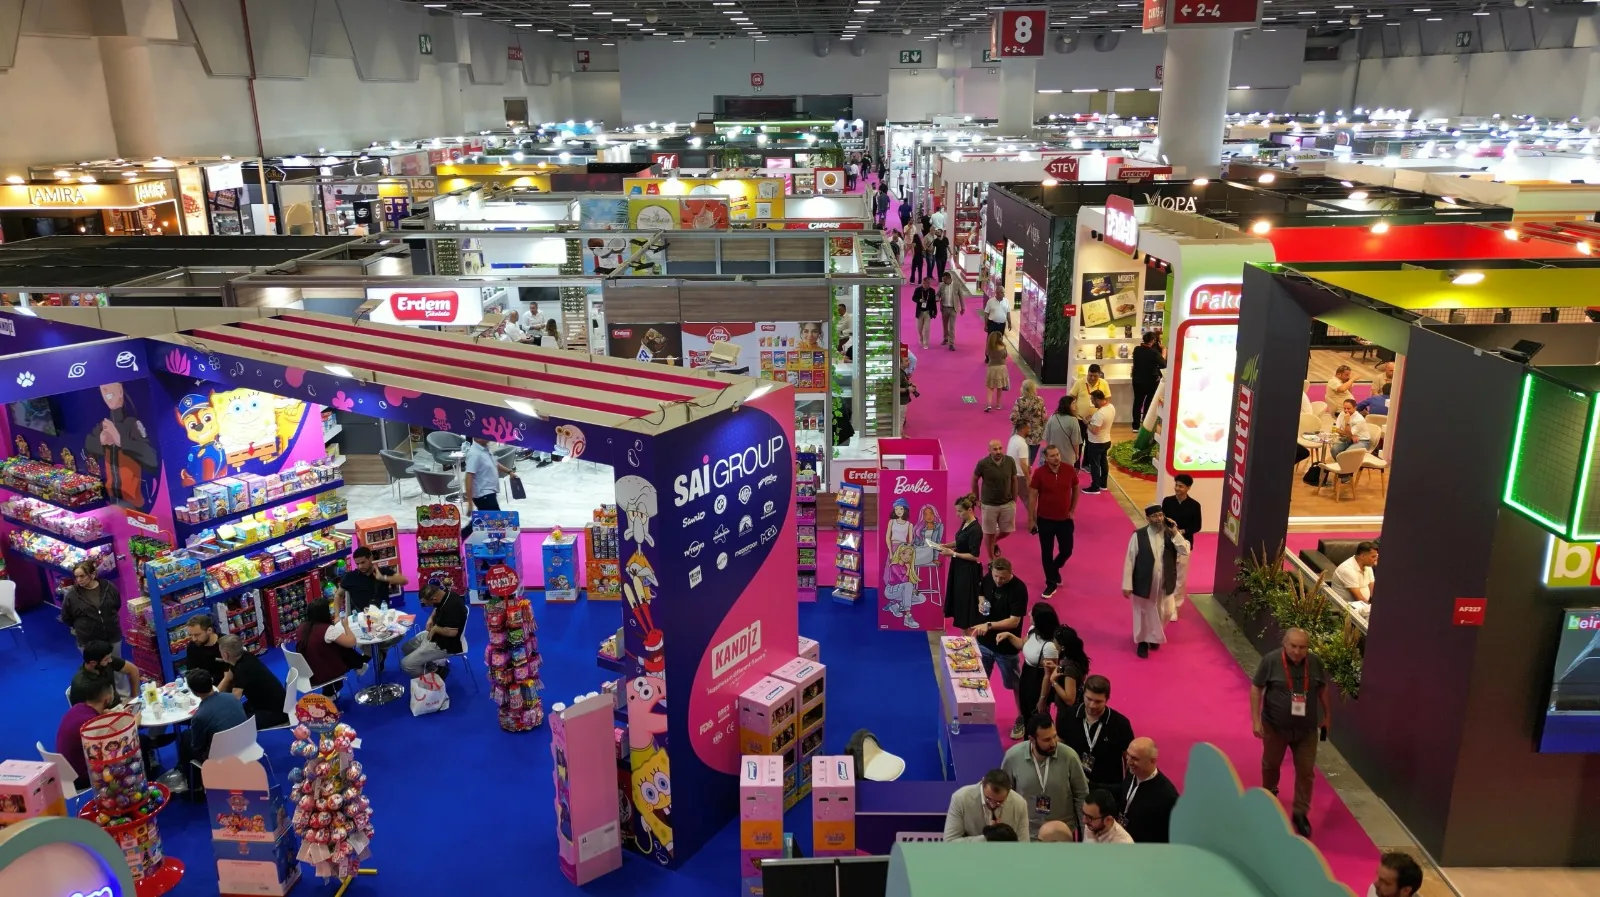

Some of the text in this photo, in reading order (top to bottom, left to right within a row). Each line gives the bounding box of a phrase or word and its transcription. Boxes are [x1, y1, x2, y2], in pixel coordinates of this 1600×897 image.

[1196, 5, 1221, 18] 2-4
[1014, 15, 1033, 44] 8
[1012, 45, 1026, 54] 2-4
[1050, 161, 1076, 174] STEV
[28, 187, 85, 206] LAMIRA
[397, 296, 451, 311] Erdem
[712, 435, 784, 488] GROUP
[893, 475, 933, 495] Barbie
[682, 511, 706, 528] Sanrio
